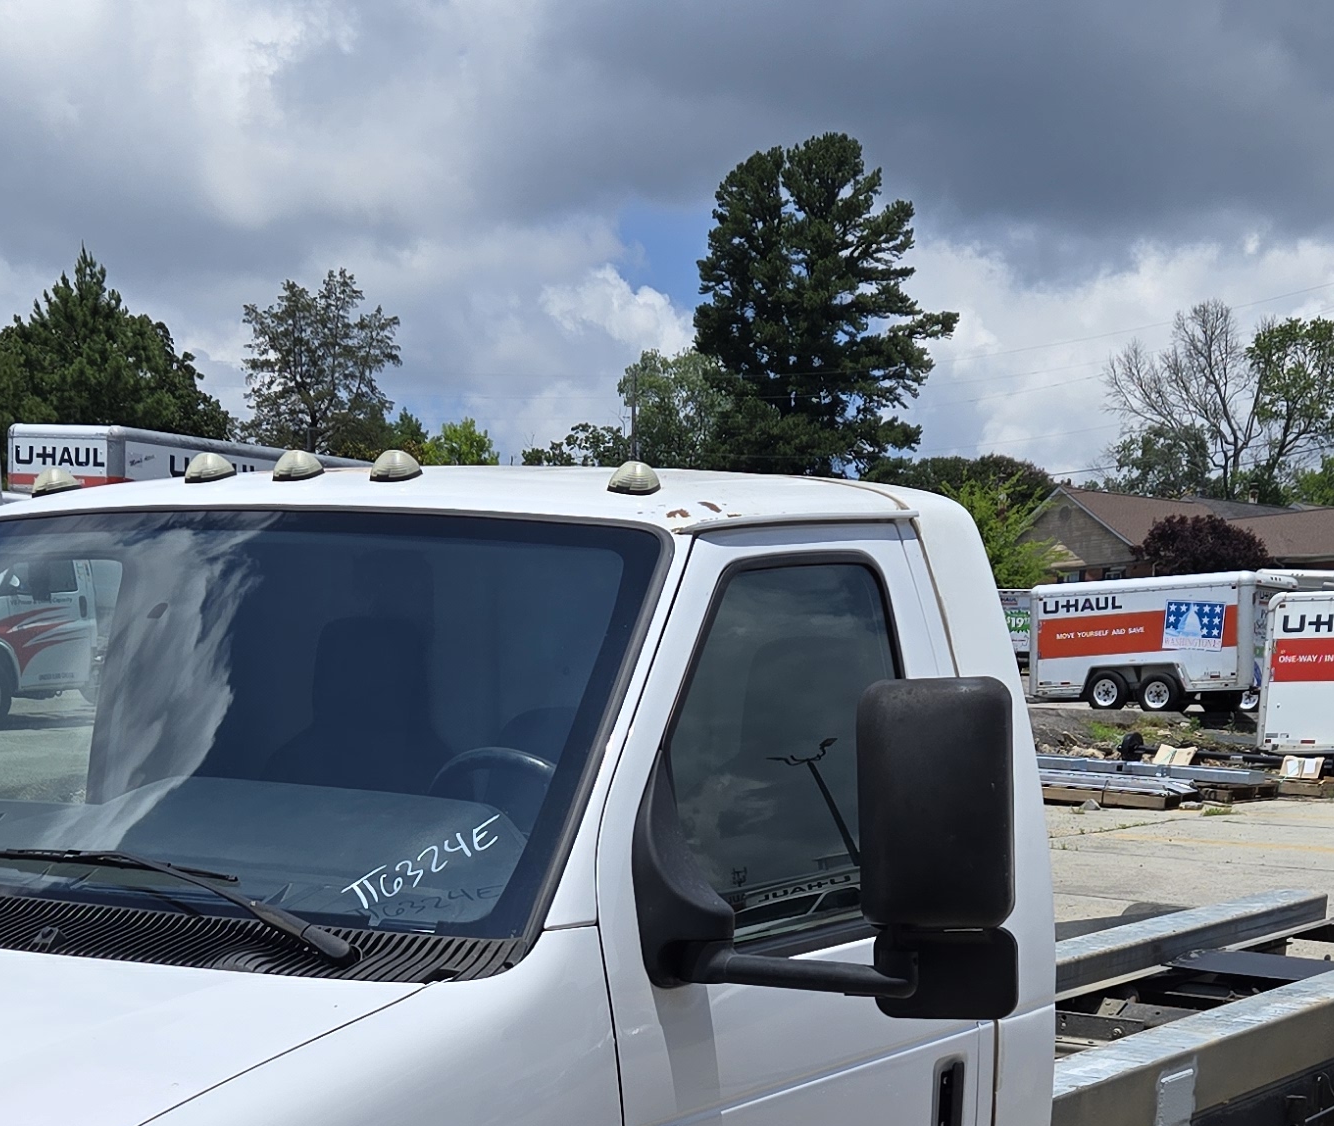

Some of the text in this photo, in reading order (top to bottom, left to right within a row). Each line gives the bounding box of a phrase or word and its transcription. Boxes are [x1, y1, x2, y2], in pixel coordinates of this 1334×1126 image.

[15, 445, 105, 468] U-HAUL
[1042, 596, 1123, 614] U-HAUL
[1056, 626, 1145, 640] MOVE YOURSELF AND SAVE
[1278, 654, 1318, 663] ONE-WAY
